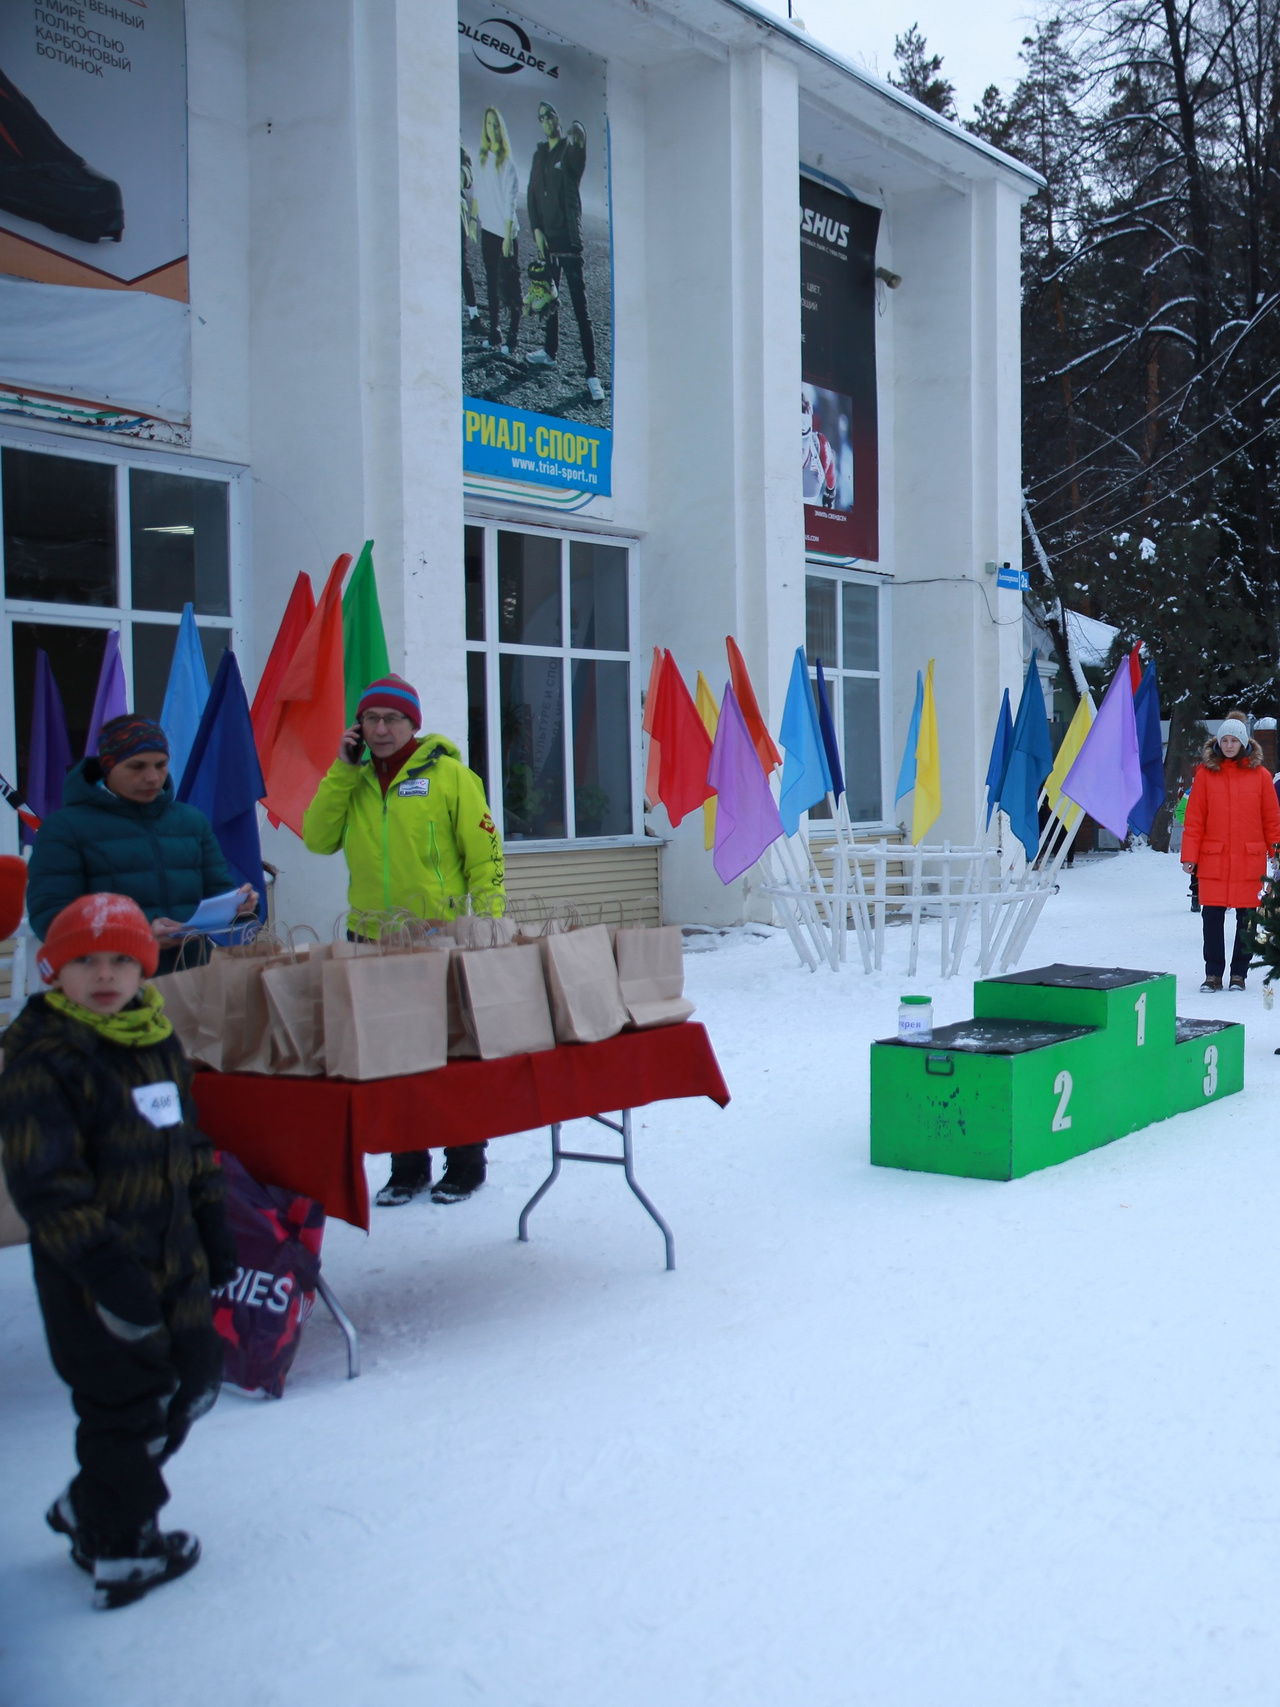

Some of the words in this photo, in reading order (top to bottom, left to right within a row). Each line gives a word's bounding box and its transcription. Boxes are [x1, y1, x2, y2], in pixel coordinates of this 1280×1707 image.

[35, 9, 125, 53] ПОЛНОСТЬЮ
[47, 0, 86, 23] МИРЕ
[72, 0, 145, 31] СТВЕННЫЙ
[36, 26, 131, 72] КАРБОНОВЫЙ
[36, 42, 104, 77] БОТИНОК
[511, 457, 598, 485] www.trial-sport.ru
[1134, 991, 1148, 1048] 1
[1202, 1044, 1219, 1098] 3
[1051, 1069, 1074, 1133] 2
[211, 1265, 294, 1313] RIES
